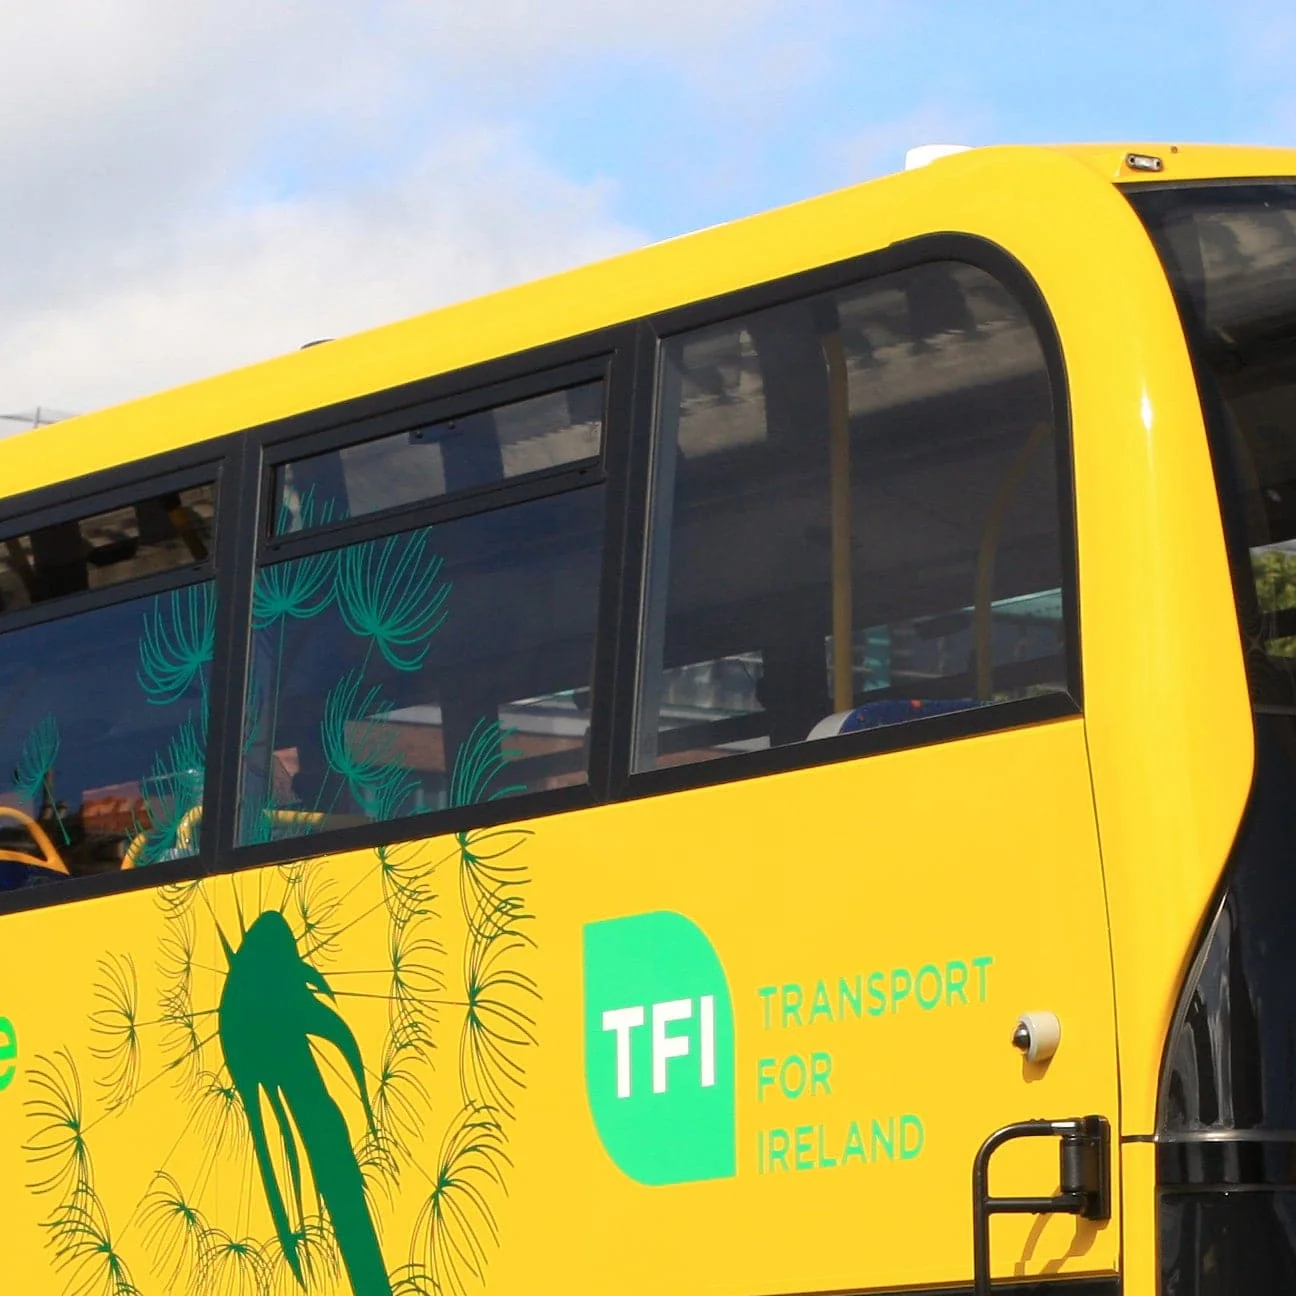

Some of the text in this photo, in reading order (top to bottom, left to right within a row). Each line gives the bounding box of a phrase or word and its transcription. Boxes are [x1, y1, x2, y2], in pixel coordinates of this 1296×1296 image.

[757, 955, 994, 1031] TRANSPORT
[601, 994, 716, 1100] TFI
[757, 1051, 833, 1102] FOR
[757, 1113, 925, 1176] IRELAND
